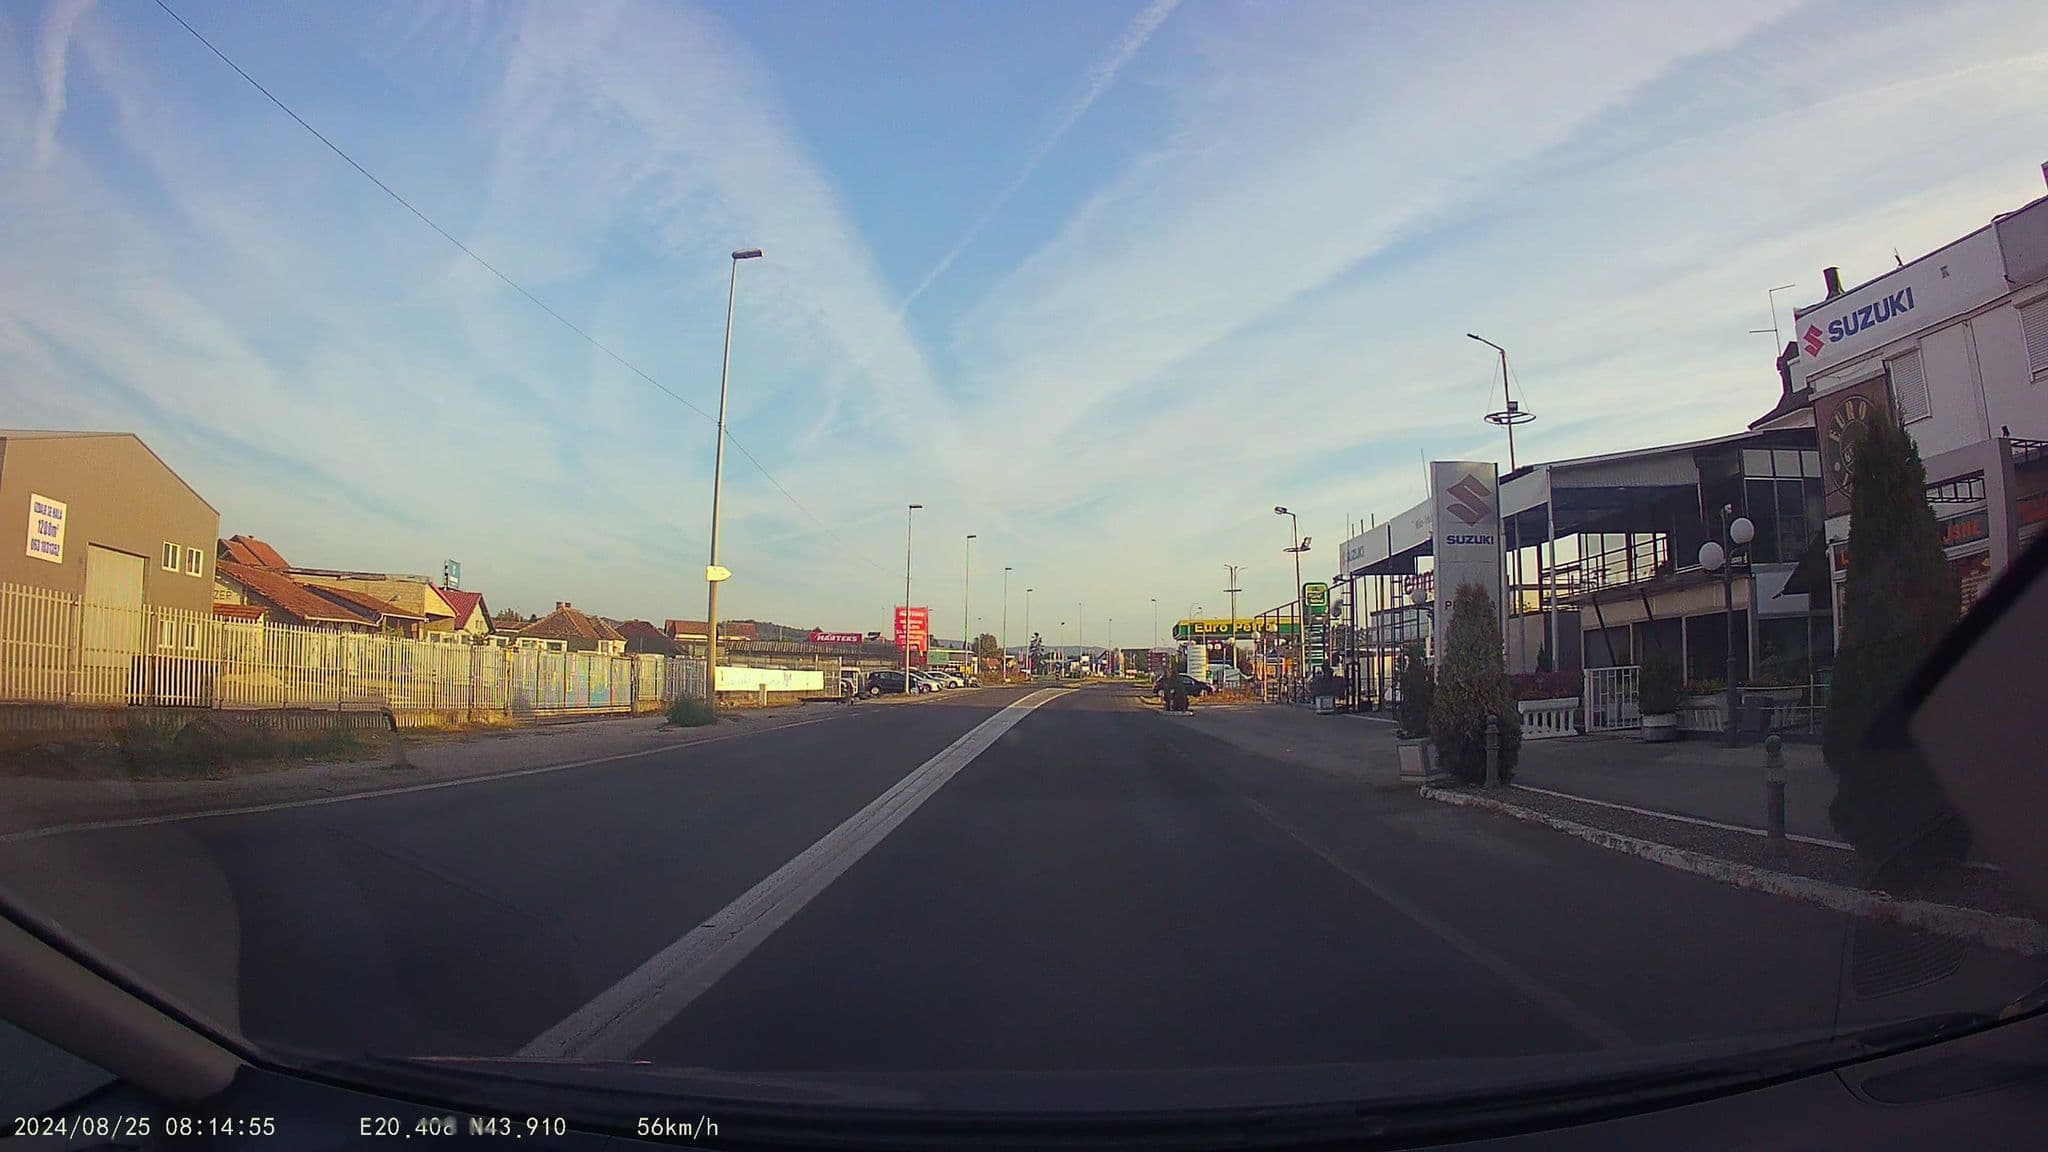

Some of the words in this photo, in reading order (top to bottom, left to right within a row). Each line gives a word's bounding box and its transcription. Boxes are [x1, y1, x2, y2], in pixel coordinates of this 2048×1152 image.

[1828, 287, 1915, 343] SUZUKI
[1446, 535, 1494, 545] SUZUKI
[1194, 623, 1228, 633] Euro
[1235, 622, 1277, 633] Petro
